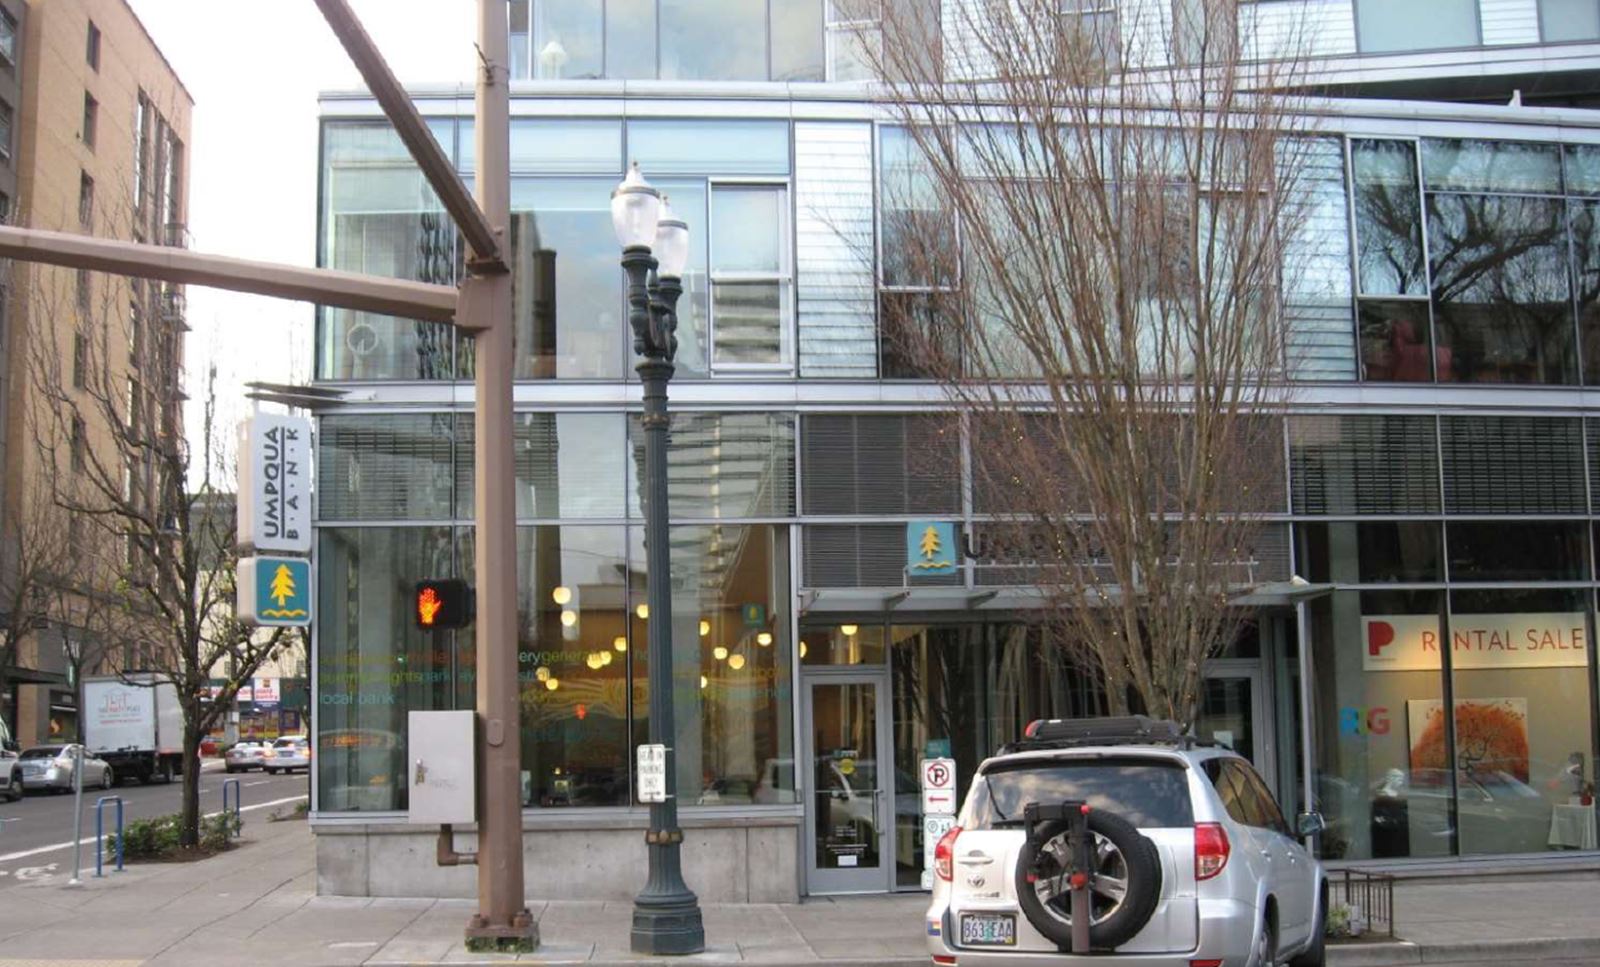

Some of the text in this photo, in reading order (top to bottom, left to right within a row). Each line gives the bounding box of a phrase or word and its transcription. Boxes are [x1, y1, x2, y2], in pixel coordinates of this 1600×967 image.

[264, 426, 280, 538] UMPQUA
[1422, 628, 1584, 651] RNTAL SALE
[519, 650, 540, 665] ery
[320, 691, 395, 705] local bank
